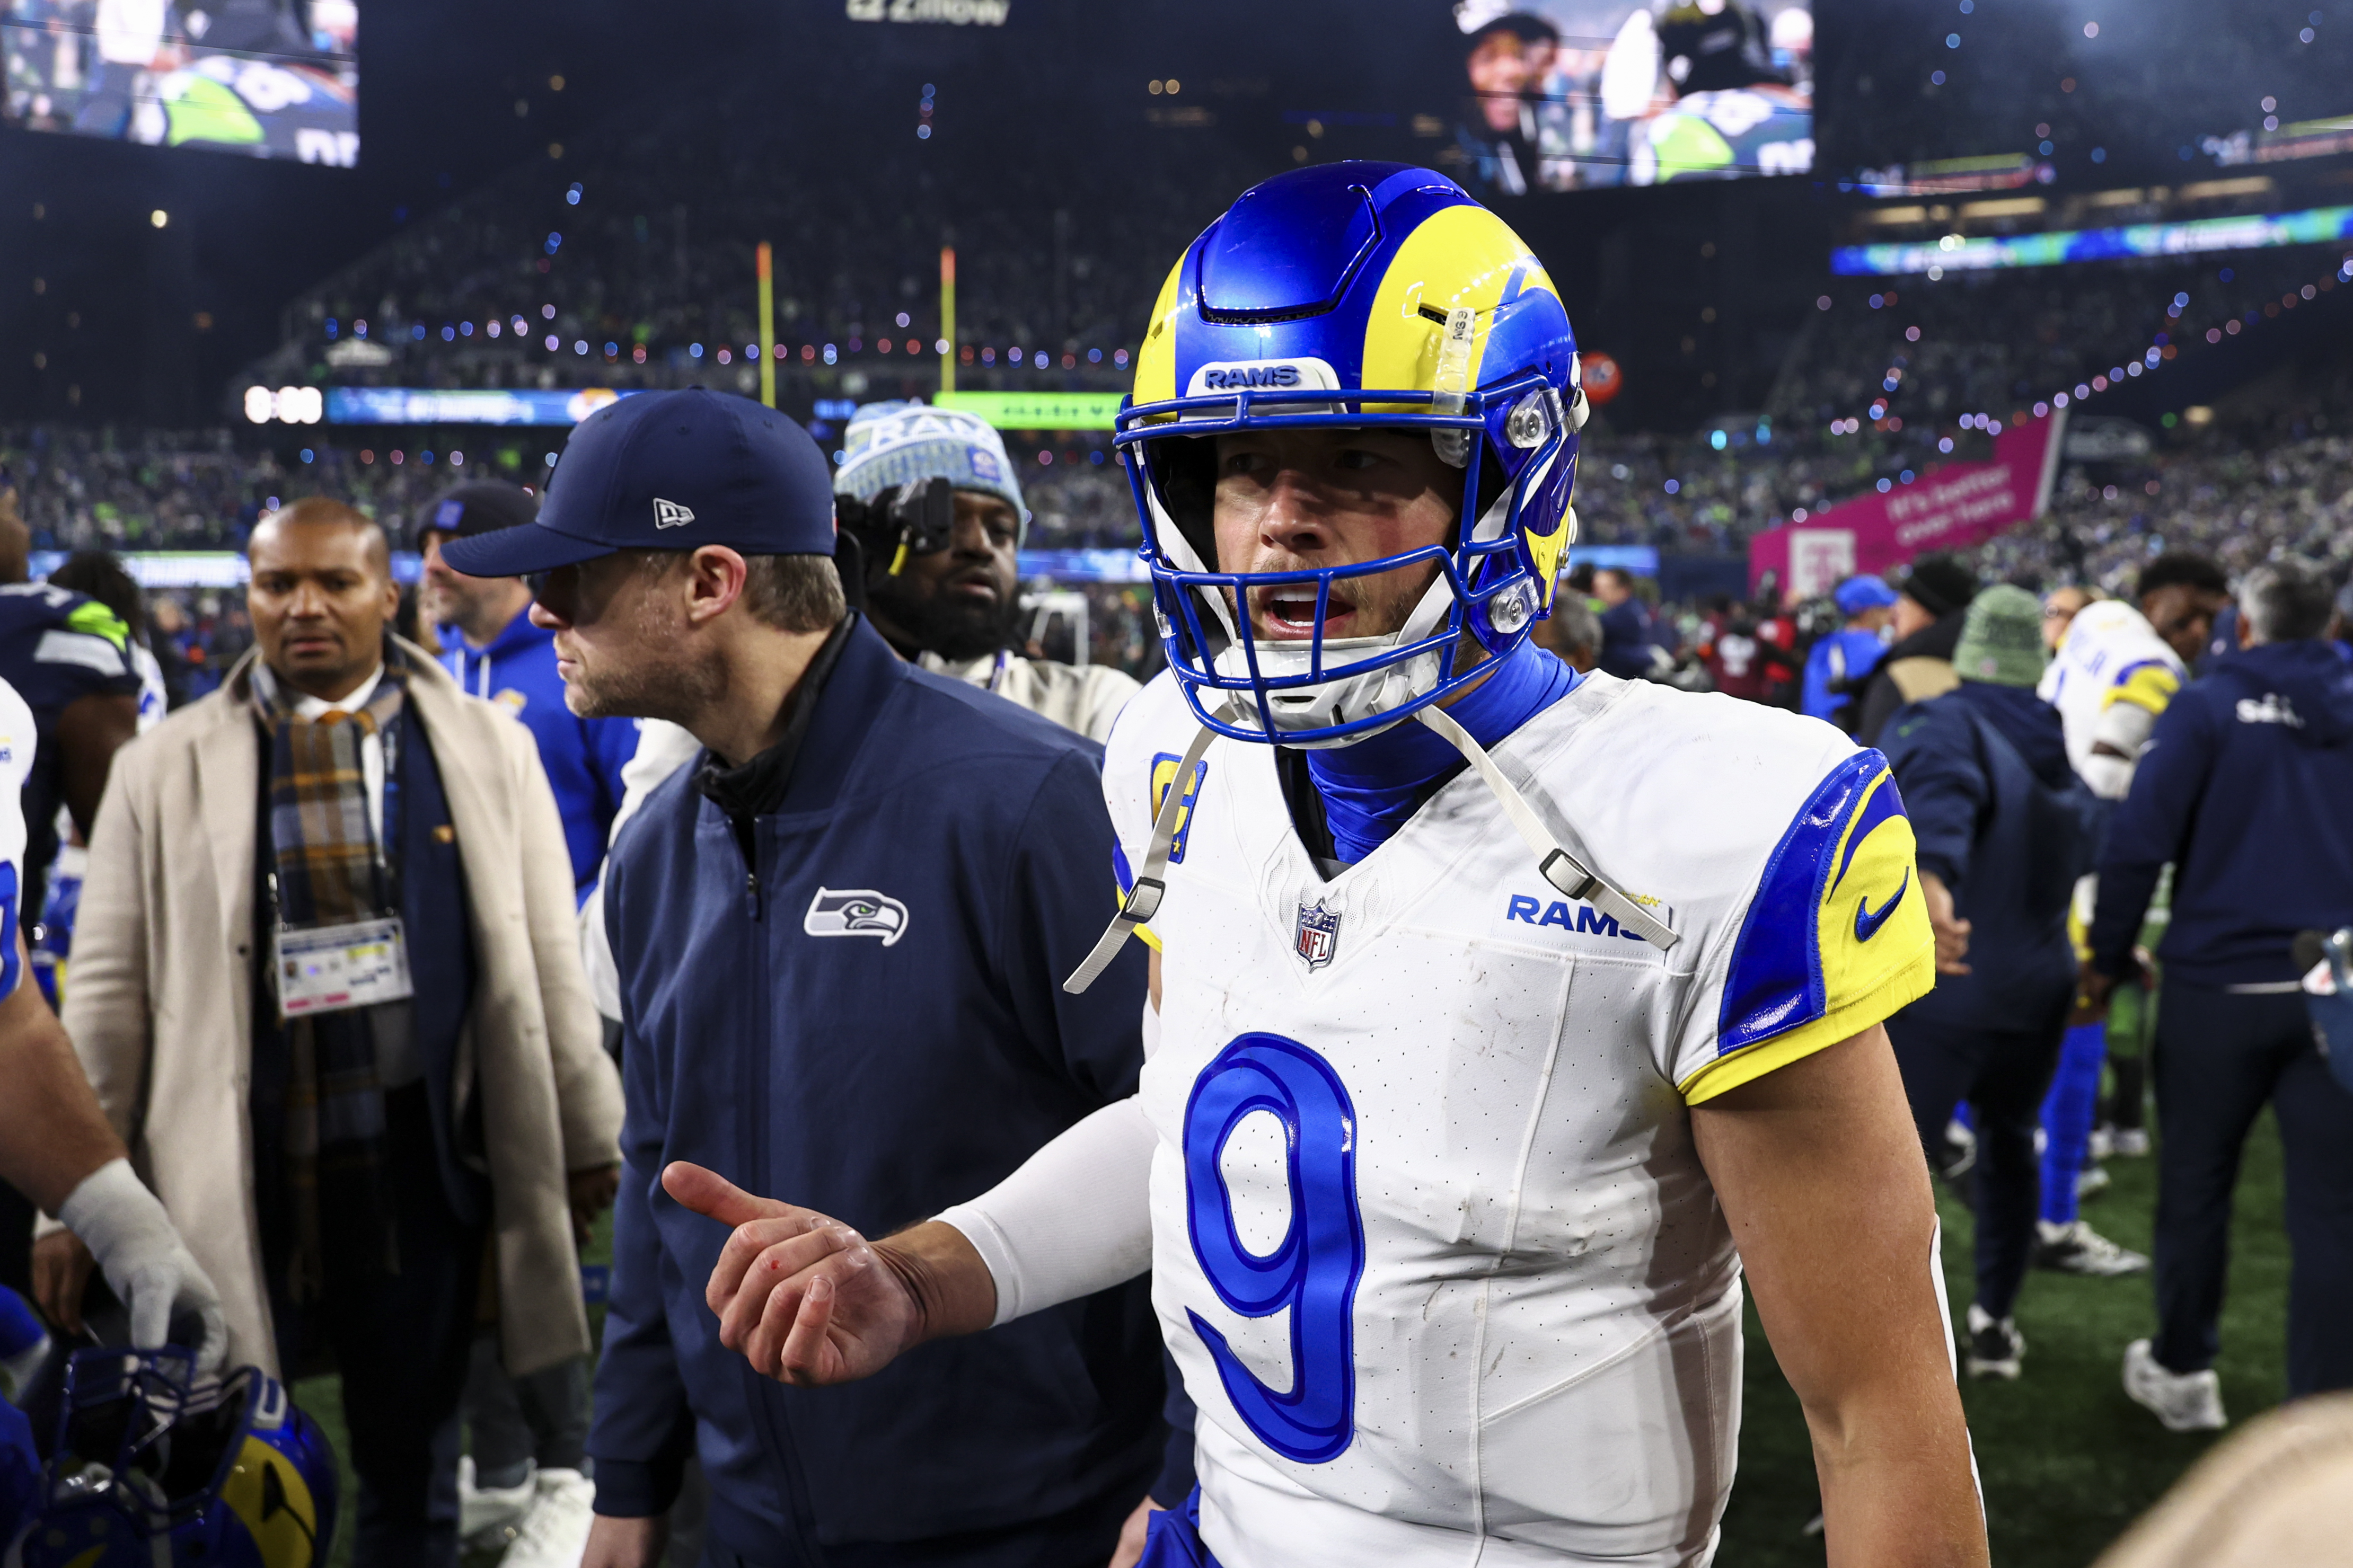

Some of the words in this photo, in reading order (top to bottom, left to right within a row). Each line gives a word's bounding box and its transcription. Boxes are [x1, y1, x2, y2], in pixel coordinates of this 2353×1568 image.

[1204, 365, 1300, 389] RAMS
[1506, 894, 1650, 942] RAM
[1299, 928, 1326, 959] NFL
[1183, 1031, 1365, 1464] 9
